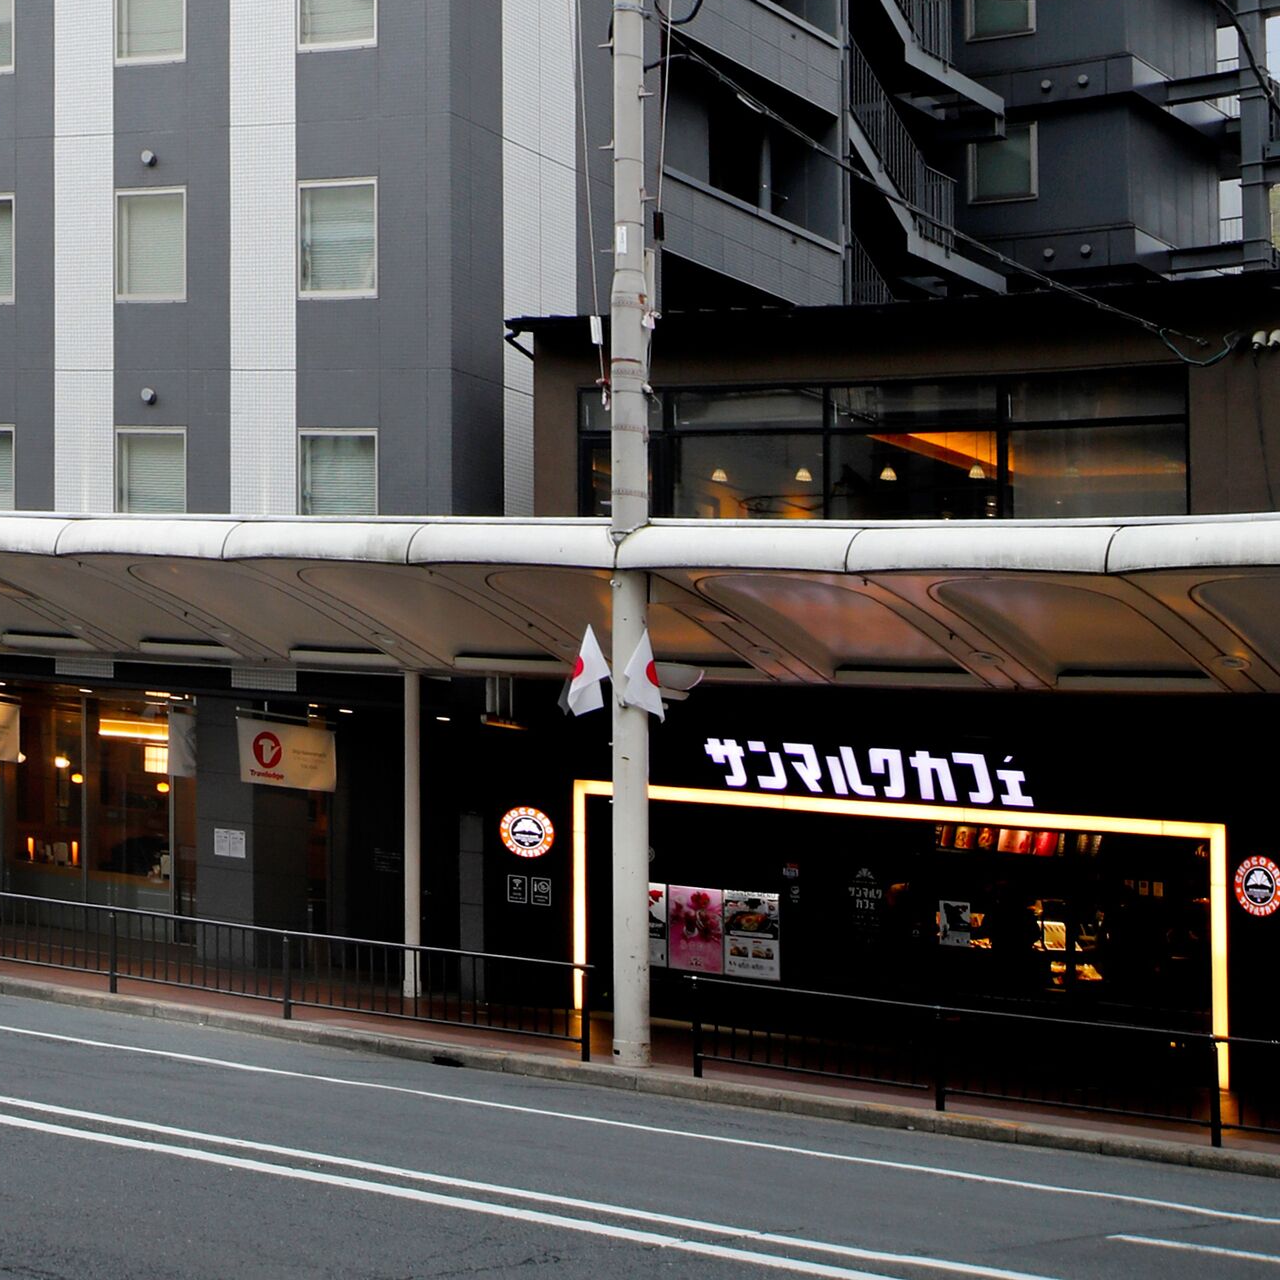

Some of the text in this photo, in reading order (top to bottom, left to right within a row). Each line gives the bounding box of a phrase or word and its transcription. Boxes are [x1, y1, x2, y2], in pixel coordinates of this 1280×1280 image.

[704, 737, 1035, 807] サンマルクカフェ
